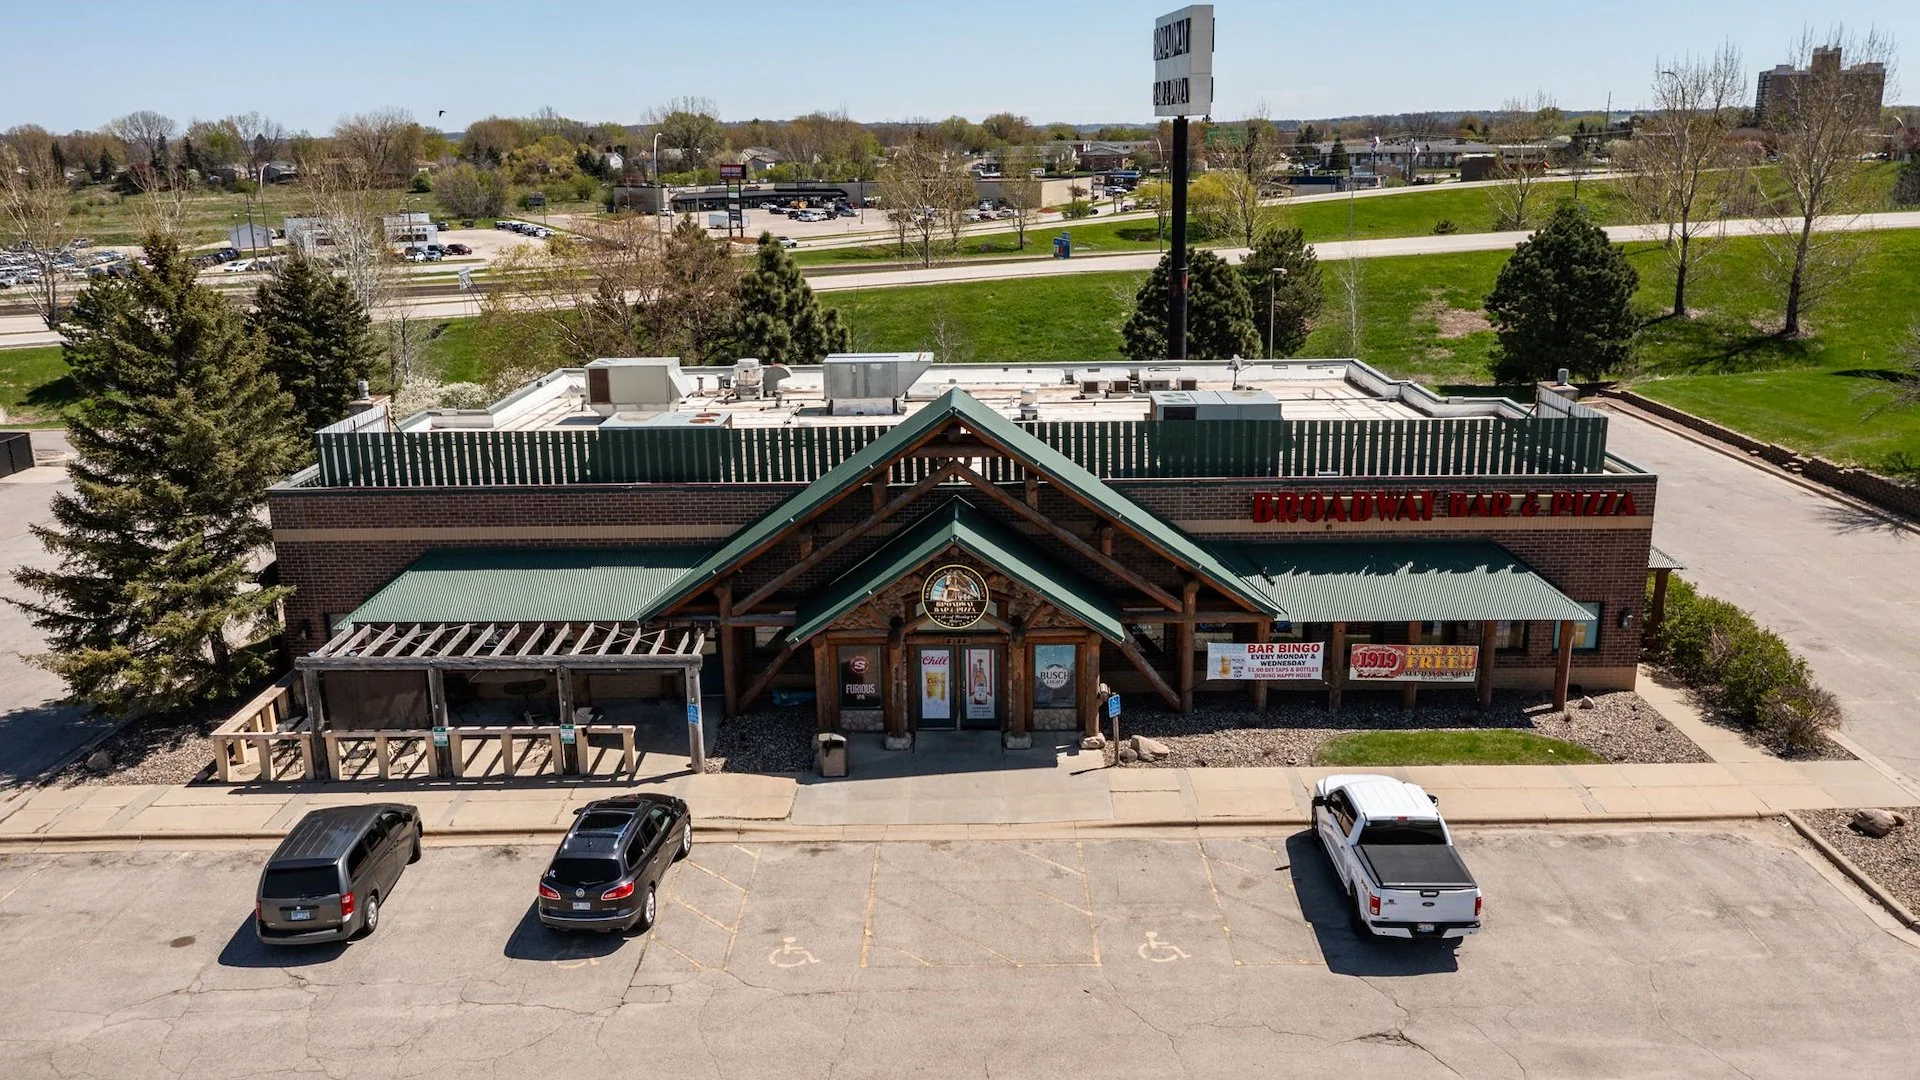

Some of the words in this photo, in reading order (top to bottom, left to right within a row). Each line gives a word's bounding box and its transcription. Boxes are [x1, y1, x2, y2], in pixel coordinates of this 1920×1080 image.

[1153, 17, 1190, 61] BROADWAY
[1252, 489, 1439, 523] BROADWAY
[1447, 490, 1510, 518] BAR
[1521, 490, 1541, 517] &
[1550, 489, 1638, 517] PIZZA
[1247, 644, 1274, 653] BAR
[1278, 644, 1320, 653] BINGO
[1407, 646, 1442, 655] KIDS
[1447, 646, 1475, 656] EAT
[922, 655, 950, 665] Chill
[1359, 652, 1397, 668] 1919
[1040, 672, 1071, 680] BUSCH
[845, 683, 876, 694] FURIOUS
